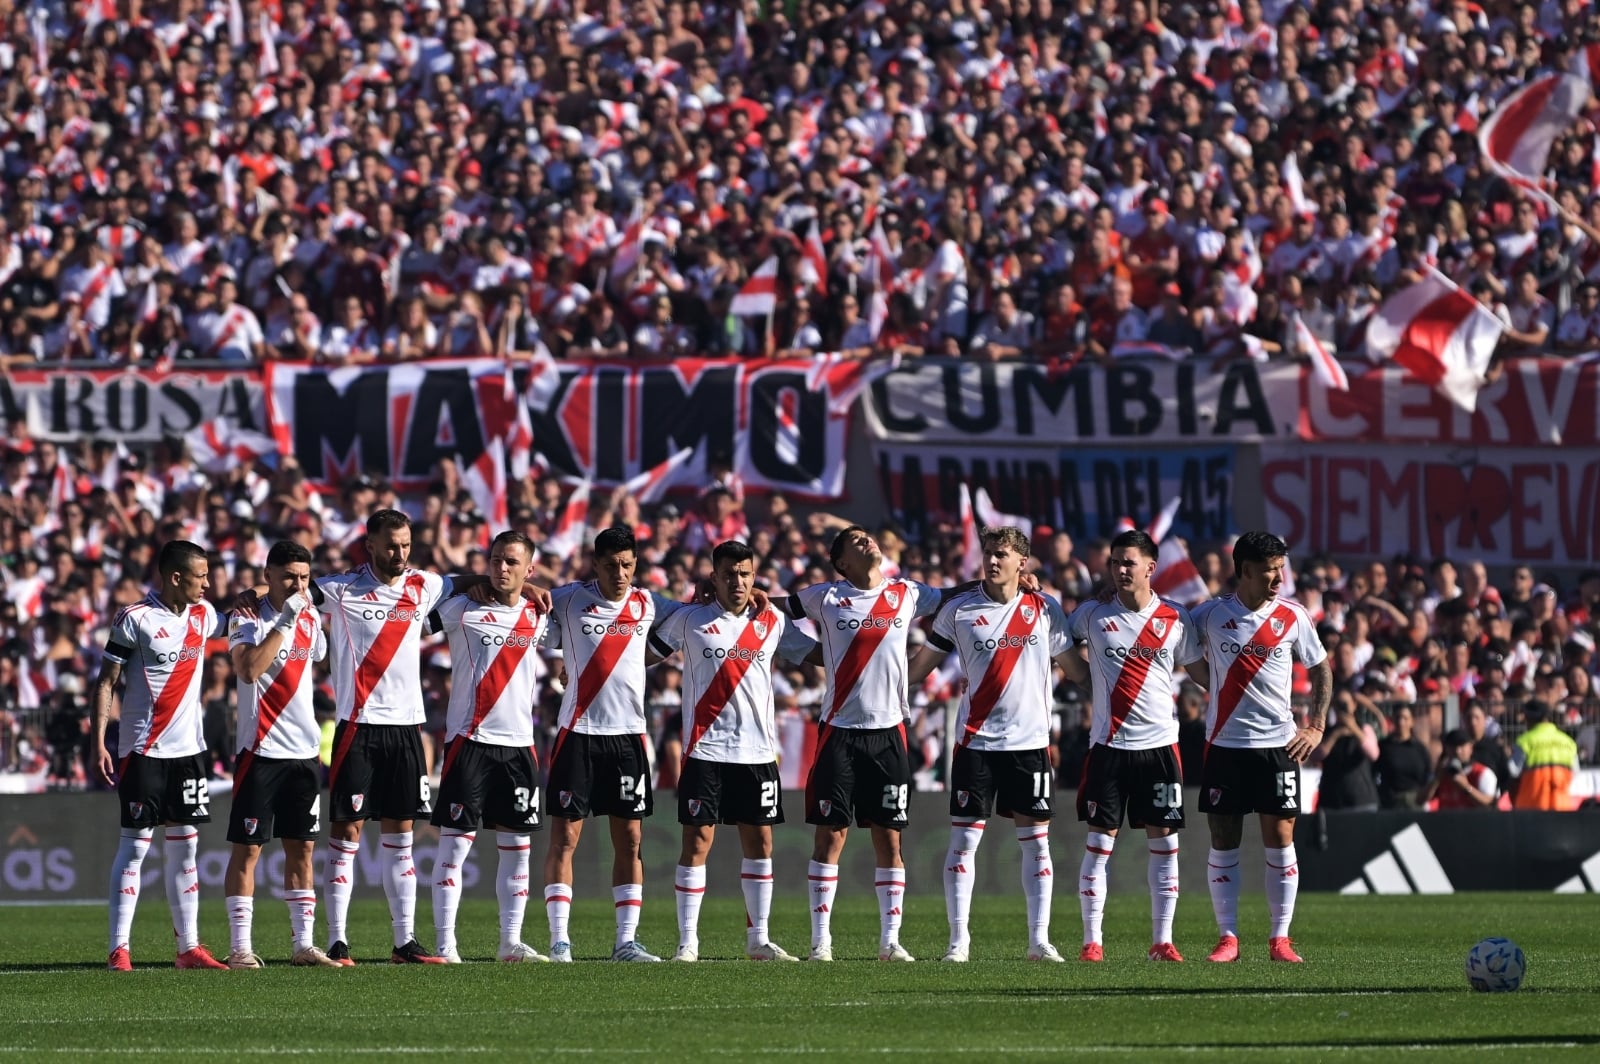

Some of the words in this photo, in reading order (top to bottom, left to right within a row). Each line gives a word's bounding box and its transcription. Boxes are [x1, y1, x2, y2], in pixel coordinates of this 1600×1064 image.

[49, 374, 257, 433] ROSA
[1309, 361, 1600, 442] CERV
[362, 605, 421, 622] codere
[836, 614, 903, 631] codere
[480, 631, 538, 648] codere
[581, 621, 644, 637] codere
[973, 632, 1038, 652] codere
[702, 643, 765, 662] codere
[1104, 641, 1168, 659] codere
[1220, 639, 1283, 659] codere
[182, 777, 210, 805] 22
[419, 774, 431, 802] 6
[620, 773, 646, 802] 24
[760, 780, 778, 807] 21
[882, 783, 907, 810] 28
[1033, 771, 1050, 798] 11
[1152, 782, 1182, 809] 30
[1276, 770, 1296, 798] 15
[513, 785, 540, 813] 34
